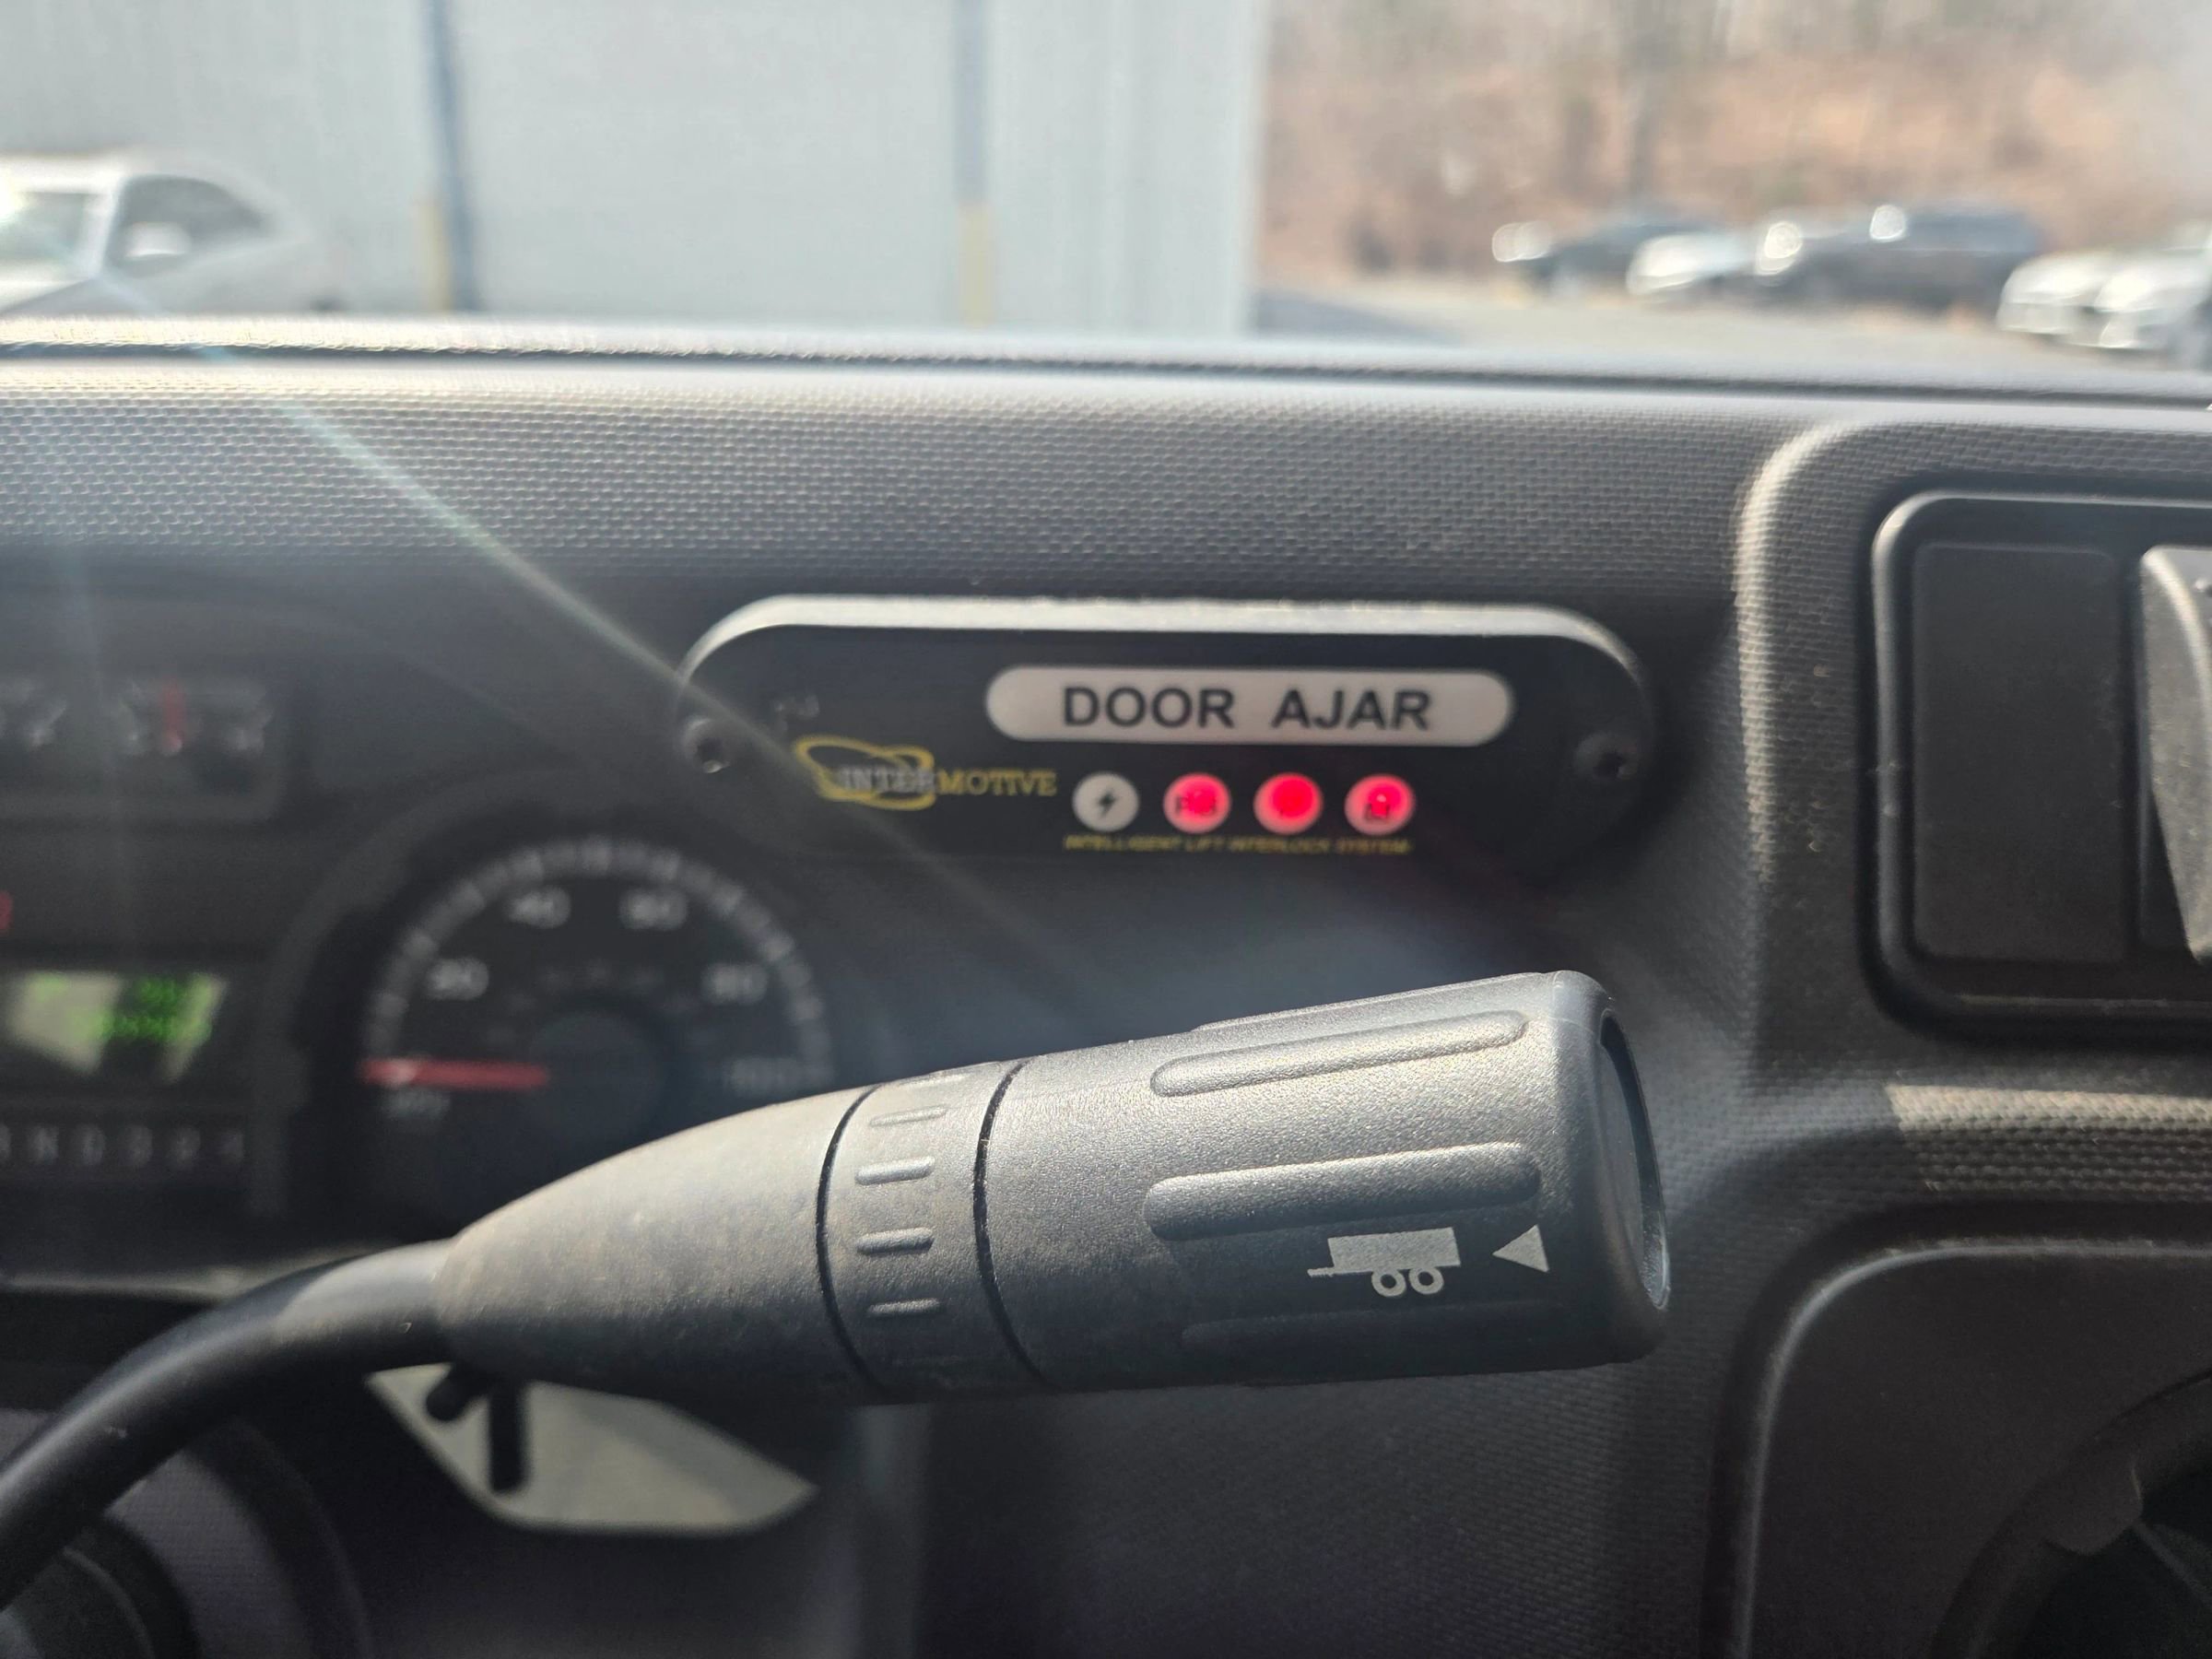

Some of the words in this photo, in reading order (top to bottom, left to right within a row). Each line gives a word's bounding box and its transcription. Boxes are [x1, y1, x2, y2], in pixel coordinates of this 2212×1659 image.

[1064, 686, 1235, 729] DOOR
[1270, 688, 1432, 731] AJAR
[1065, 835, 1181, 851] INTELLIGENT
[1185, 836, 1225, 852] LIFT
